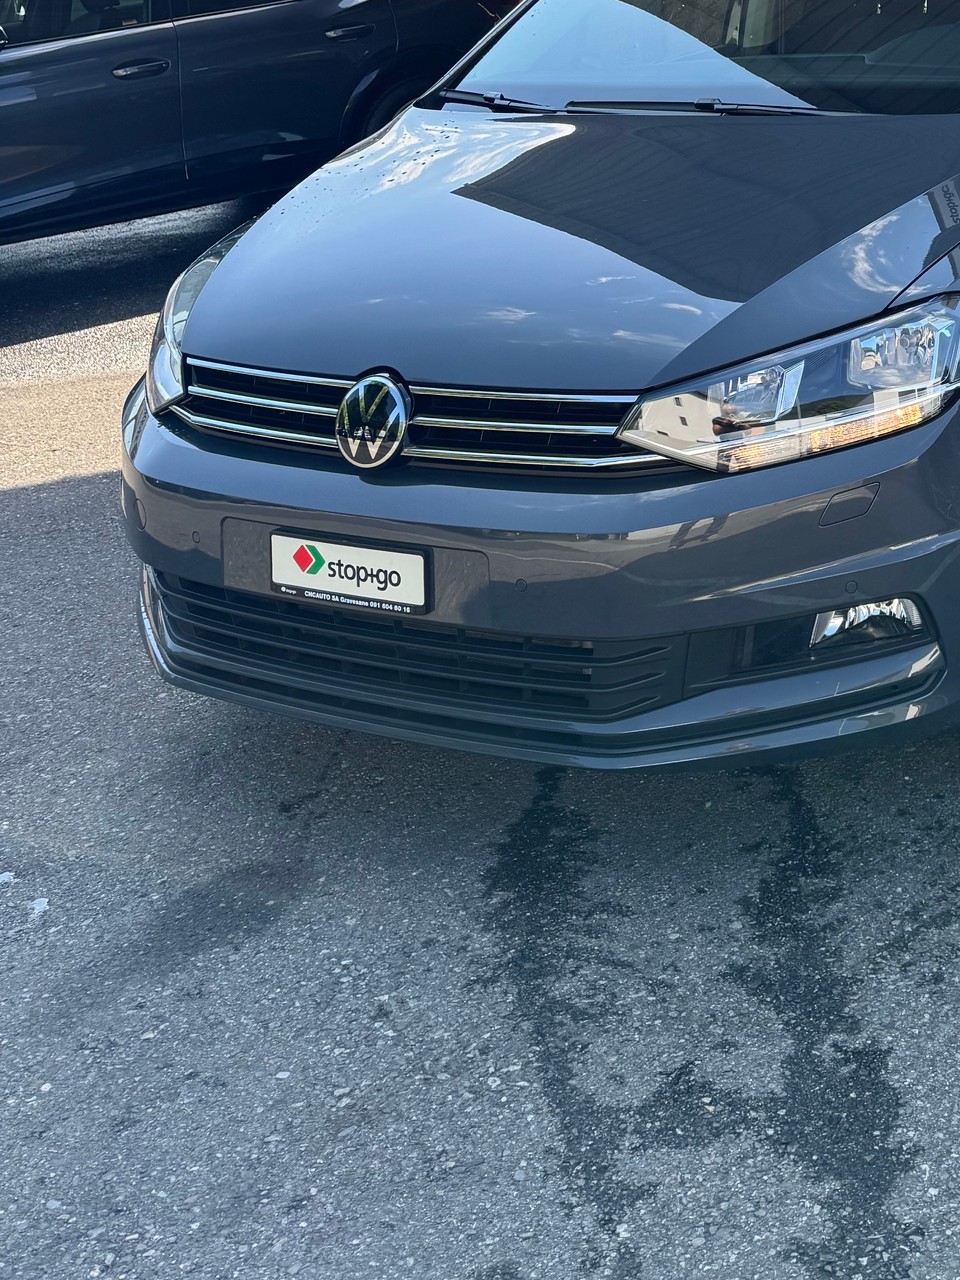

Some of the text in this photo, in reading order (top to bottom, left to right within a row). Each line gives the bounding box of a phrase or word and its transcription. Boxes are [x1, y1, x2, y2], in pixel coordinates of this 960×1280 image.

[327, 559, 402, 592] stop+go
[304, 590, 331, 601] CNCAUTO
[331, 594, 340, 602] SA
[369, 600, 381, 608] 091
